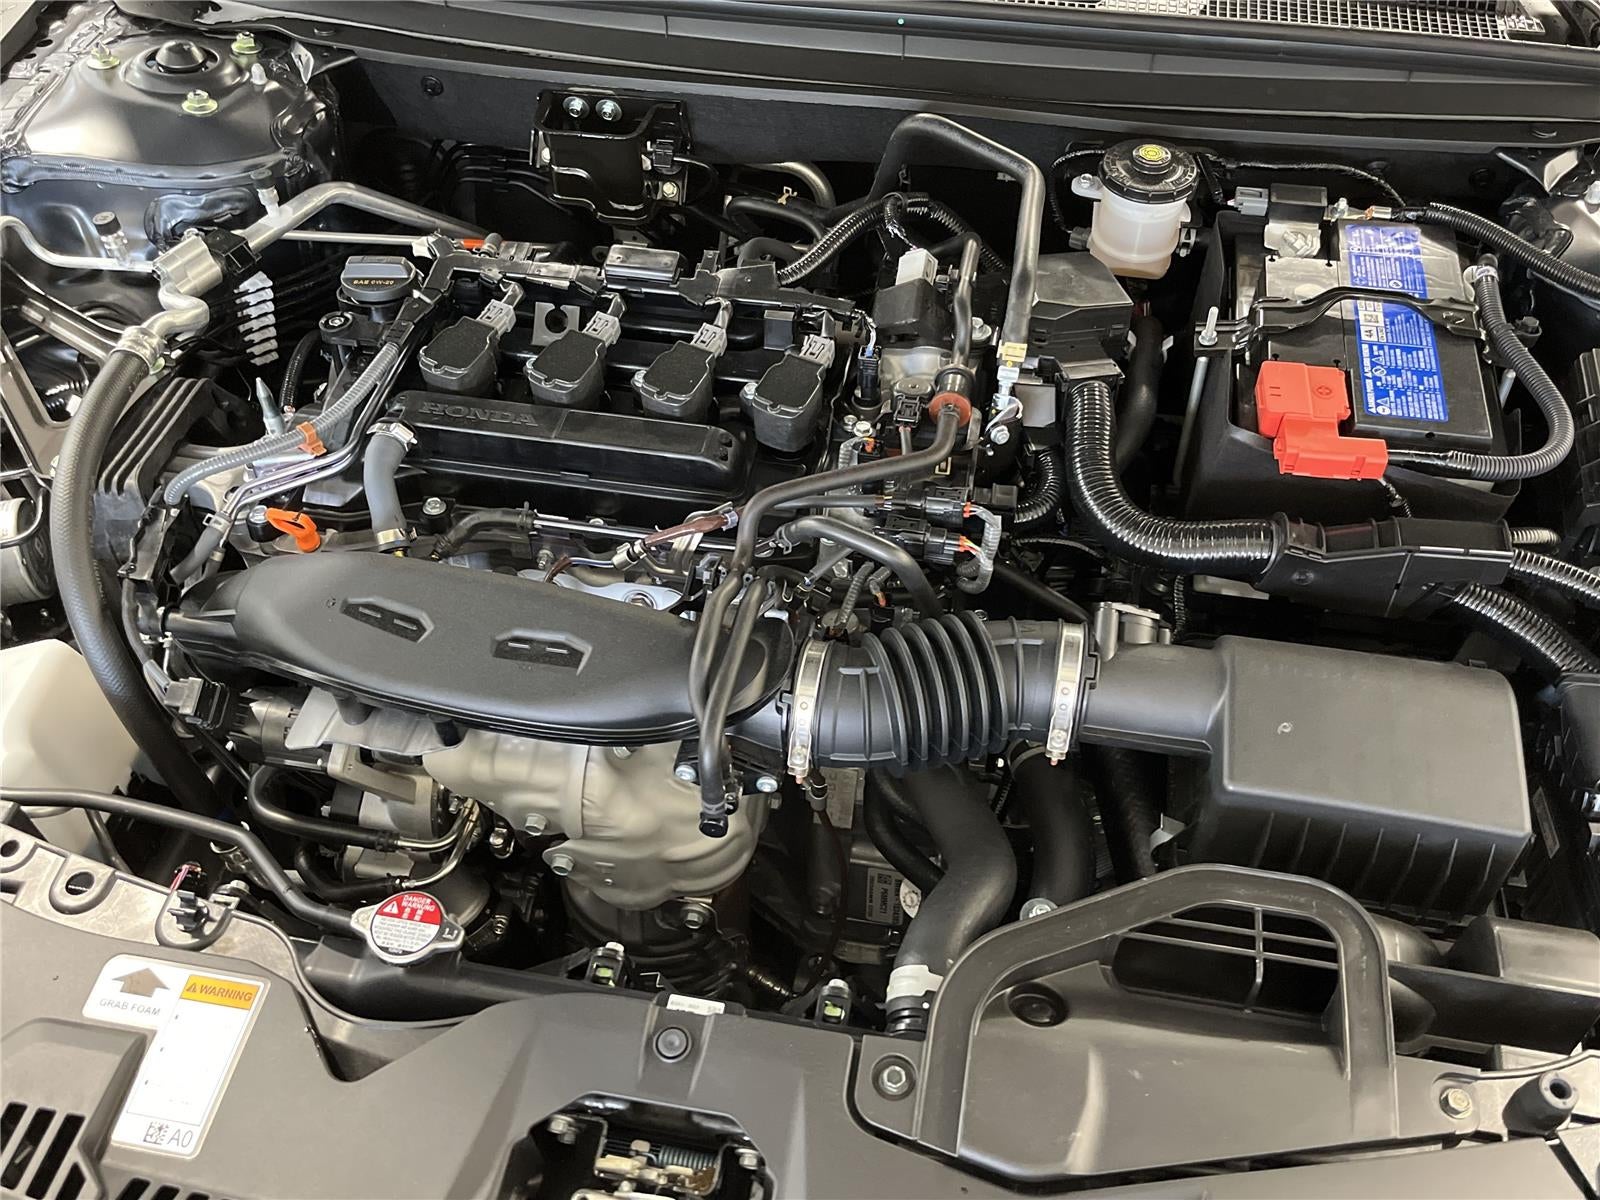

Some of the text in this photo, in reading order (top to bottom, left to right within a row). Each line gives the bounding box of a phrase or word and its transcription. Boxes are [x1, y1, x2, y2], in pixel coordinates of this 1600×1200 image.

[1364, 329, 1374, 339] 4A
[418, 402, 538, 426] HONDA
[403, 894, 432, 904] DANGER
[200, 984, 253, 1001] WARNING
[99, 998, 160, 1016] GRAB FOAM
